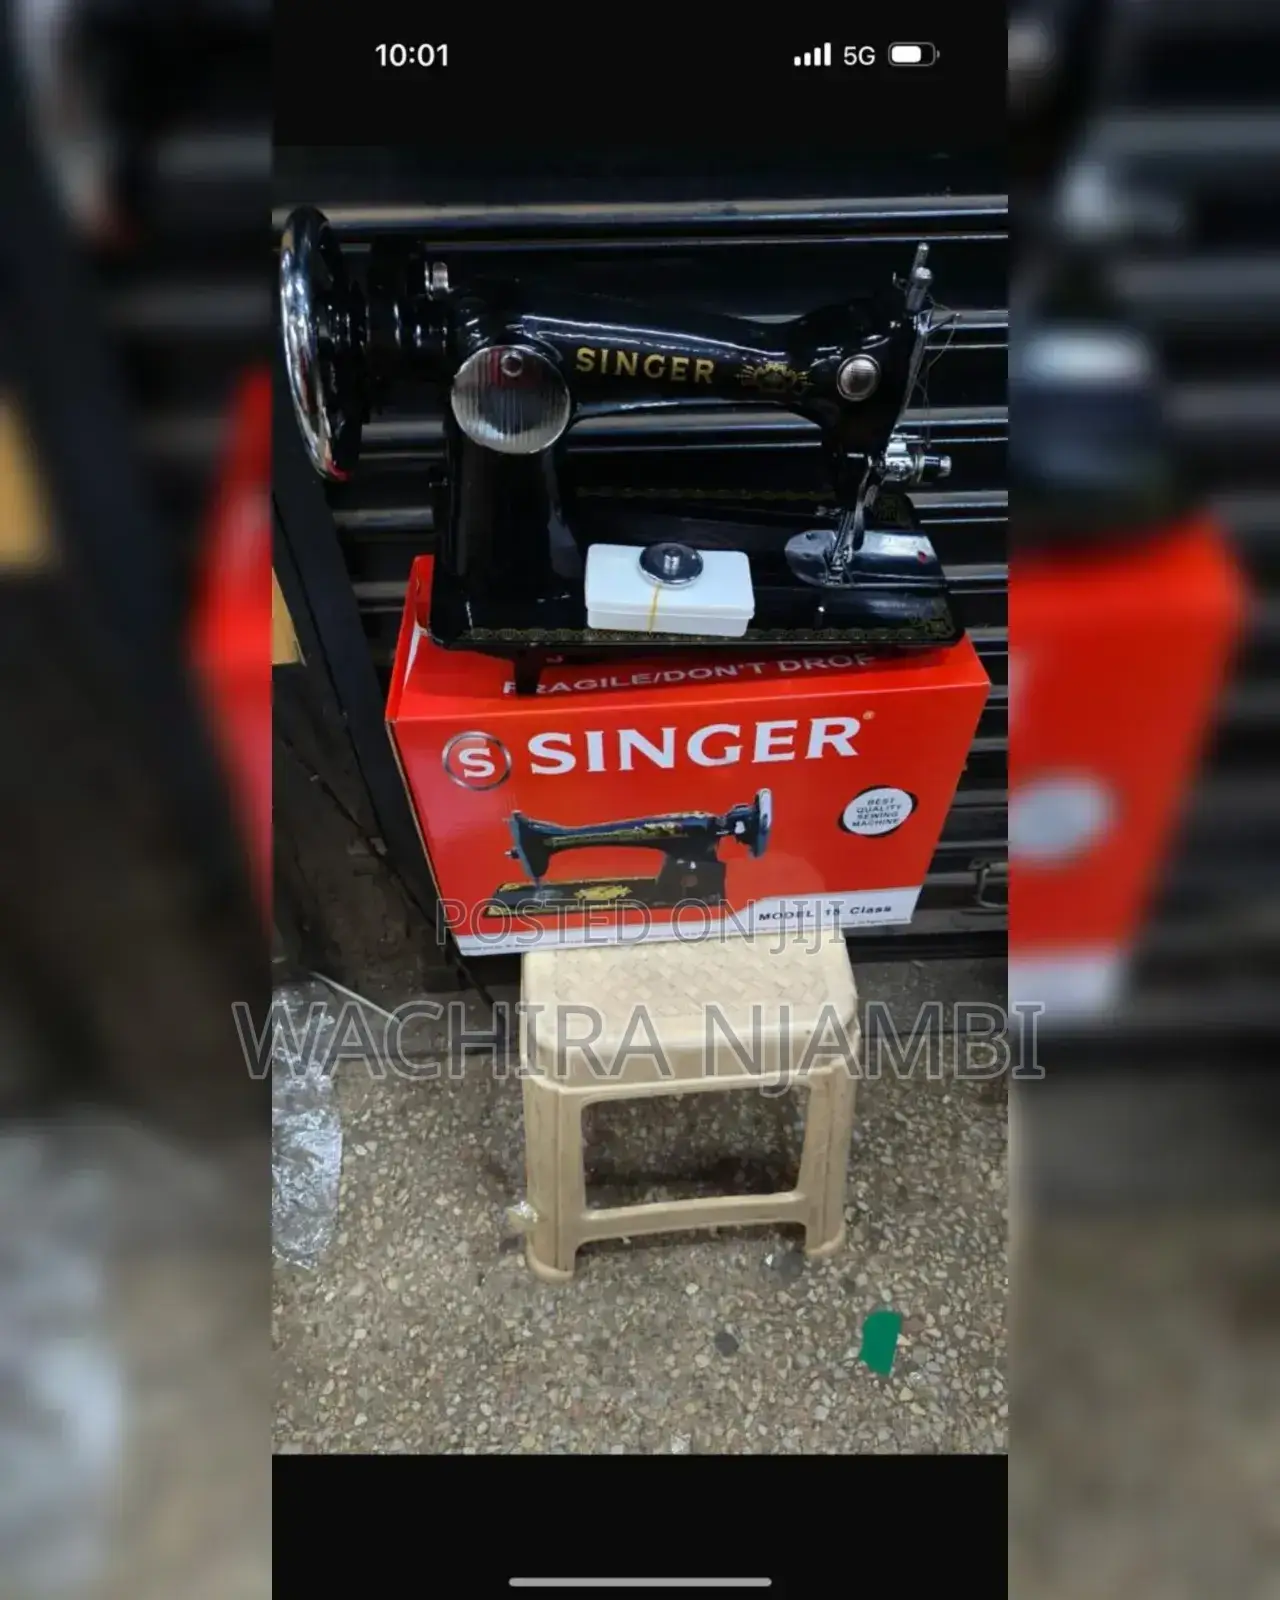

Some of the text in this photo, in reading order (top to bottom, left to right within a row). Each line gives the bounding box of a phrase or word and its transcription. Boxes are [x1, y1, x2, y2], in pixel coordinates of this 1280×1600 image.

[575, 347, 715, 384] SINGER
[527, 716, 861, 777] SINGER
[856, 804, 902, 813] QUALITY
[857, 811, 899, 820] SEWING
[758, 910, 815, 921] MODEL
[850, 905, 892, 915] Class
